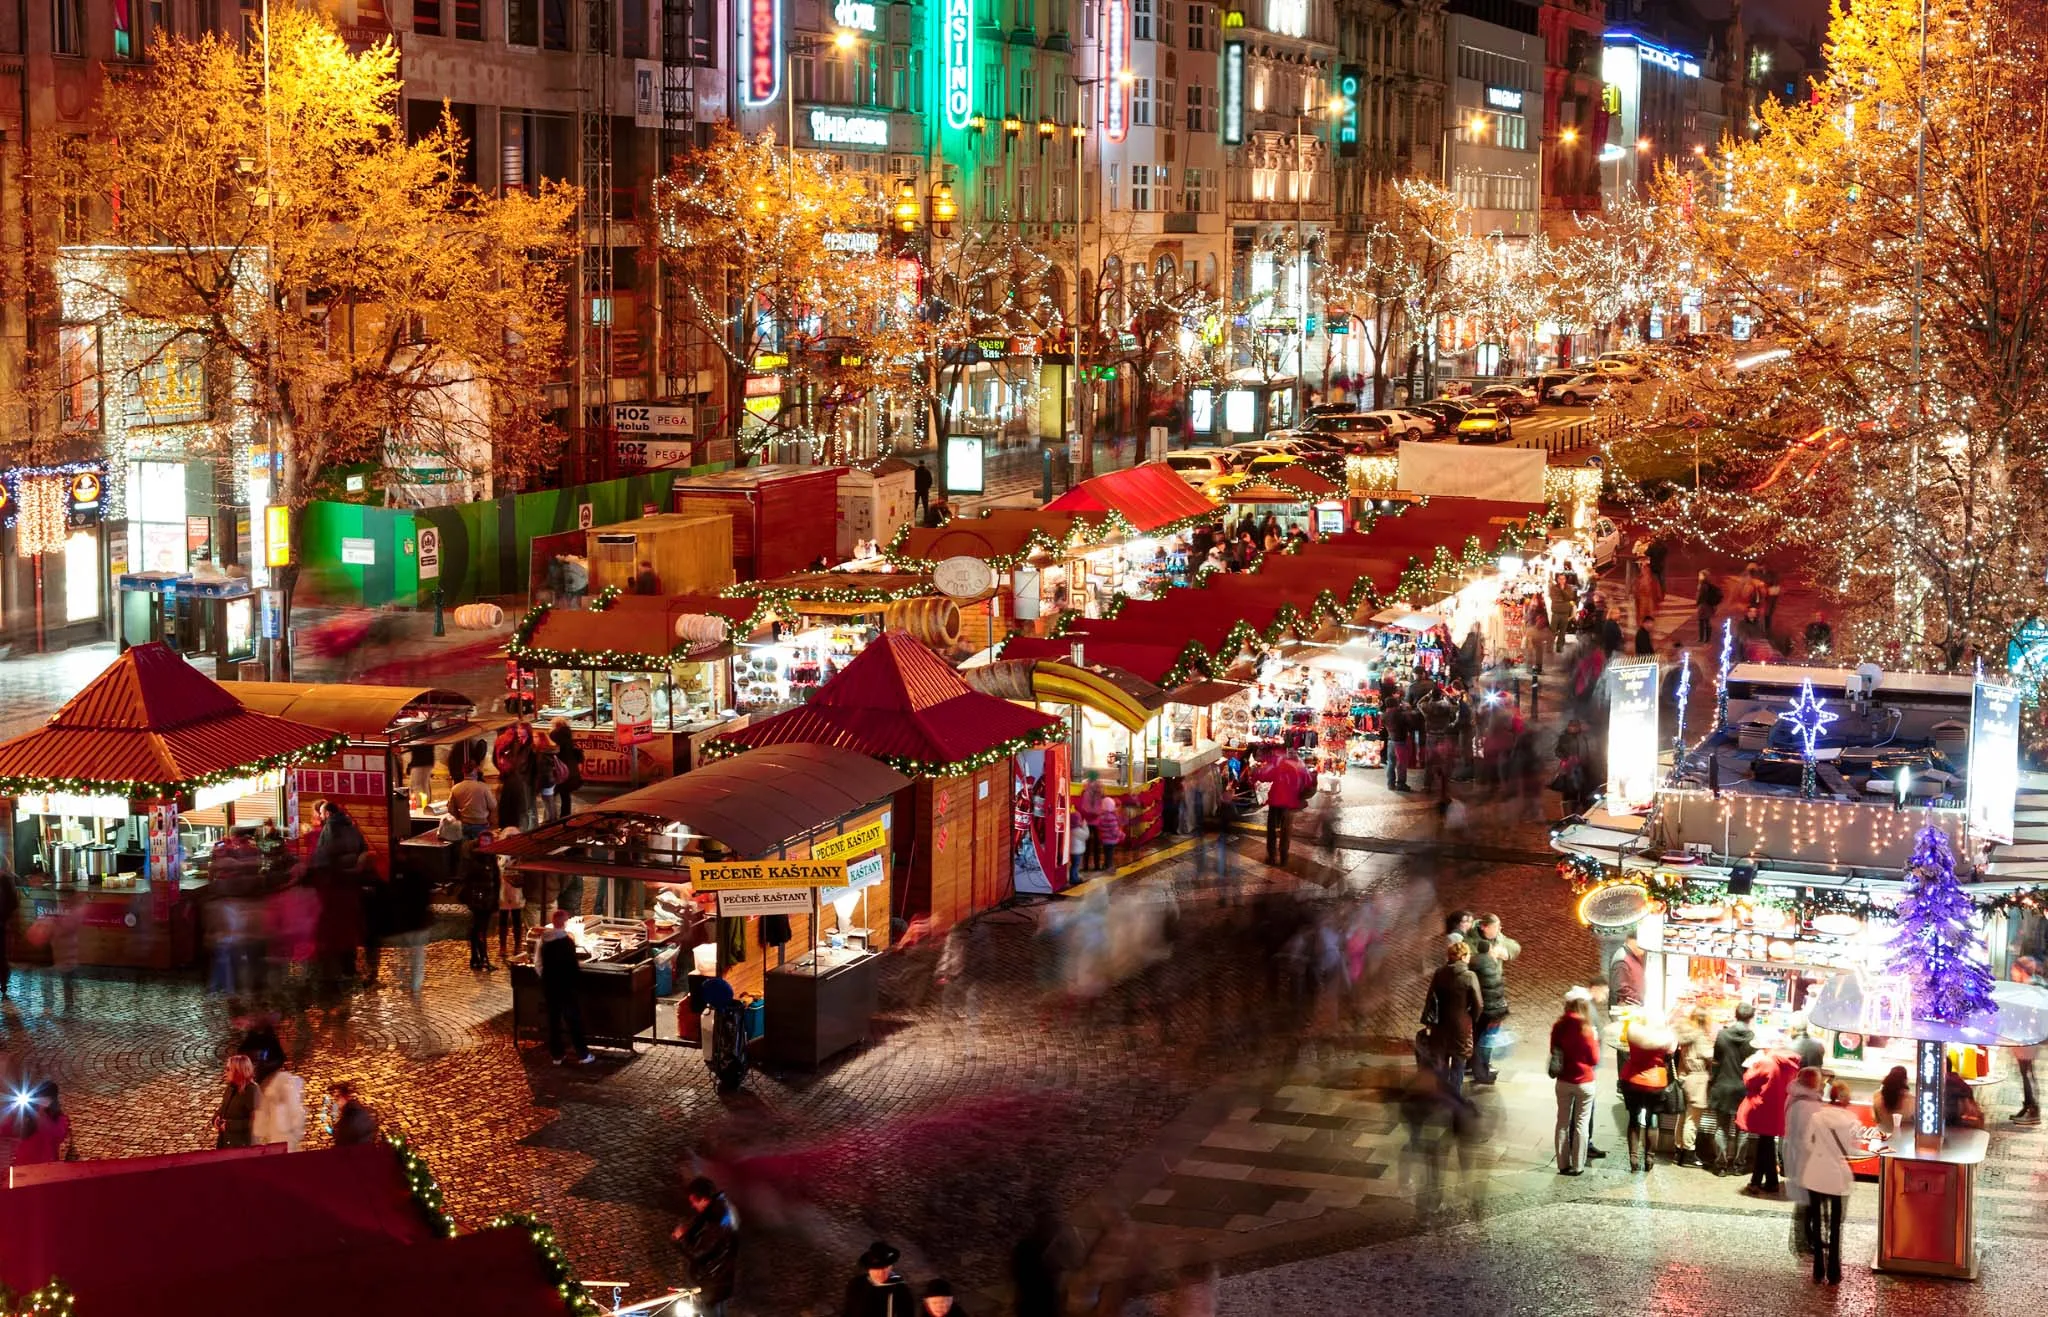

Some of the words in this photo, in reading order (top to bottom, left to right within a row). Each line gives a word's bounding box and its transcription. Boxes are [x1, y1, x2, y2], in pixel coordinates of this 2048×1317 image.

[616, 408, 649, 420] HOZ
[657, 416, 687, 425] PEGA
[617, 422, 650, 431] Holub
[617, 443, 647, 455] HOZ
[655, 451, 685, 460] PEGA
[846, 826, 880, 848] KAŠTANY
[700, 865, 763, 880] PEČENÉ
[768, 864, 842, 879] KAŠTANY
[723, 893, 760, 903] PEČENÉ
[763, 892, 808, 902] KAŠTANY
[1924, 1043, 1936, 1084] FAST
[1922, 1092, 1935, 1134] FOOD
